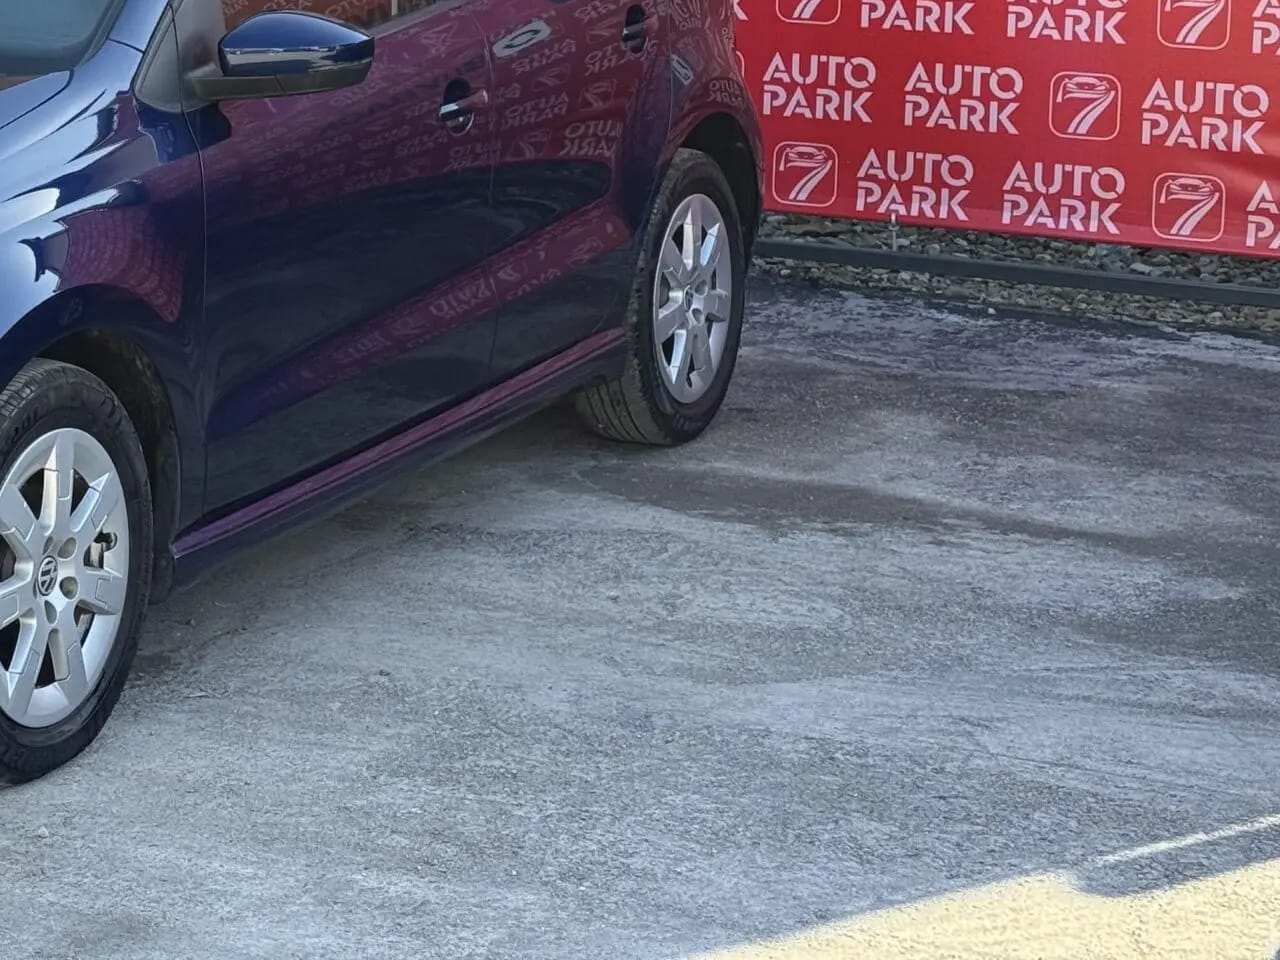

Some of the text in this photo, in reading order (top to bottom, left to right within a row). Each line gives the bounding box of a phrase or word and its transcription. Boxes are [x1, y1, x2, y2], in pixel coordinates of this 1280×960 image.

[1007, 5, 1126, 44] PARK
[763, 52, 876, 88] AUTO
[904, 62, 1023, 99] AUTO
[763, 84, 872, 122] PARK
[905, 95, 1019, 134] PARK
[1142, 78, 1269, 117] AUTO
[1142, 112, 1264, 154] PARK
[857, 148, 973, 186] AUTO
[1003, 161, 1125, 199] AUTO
[856, 181, 970, 222] PARK
[1002, 194, 1121, 234] PARK
